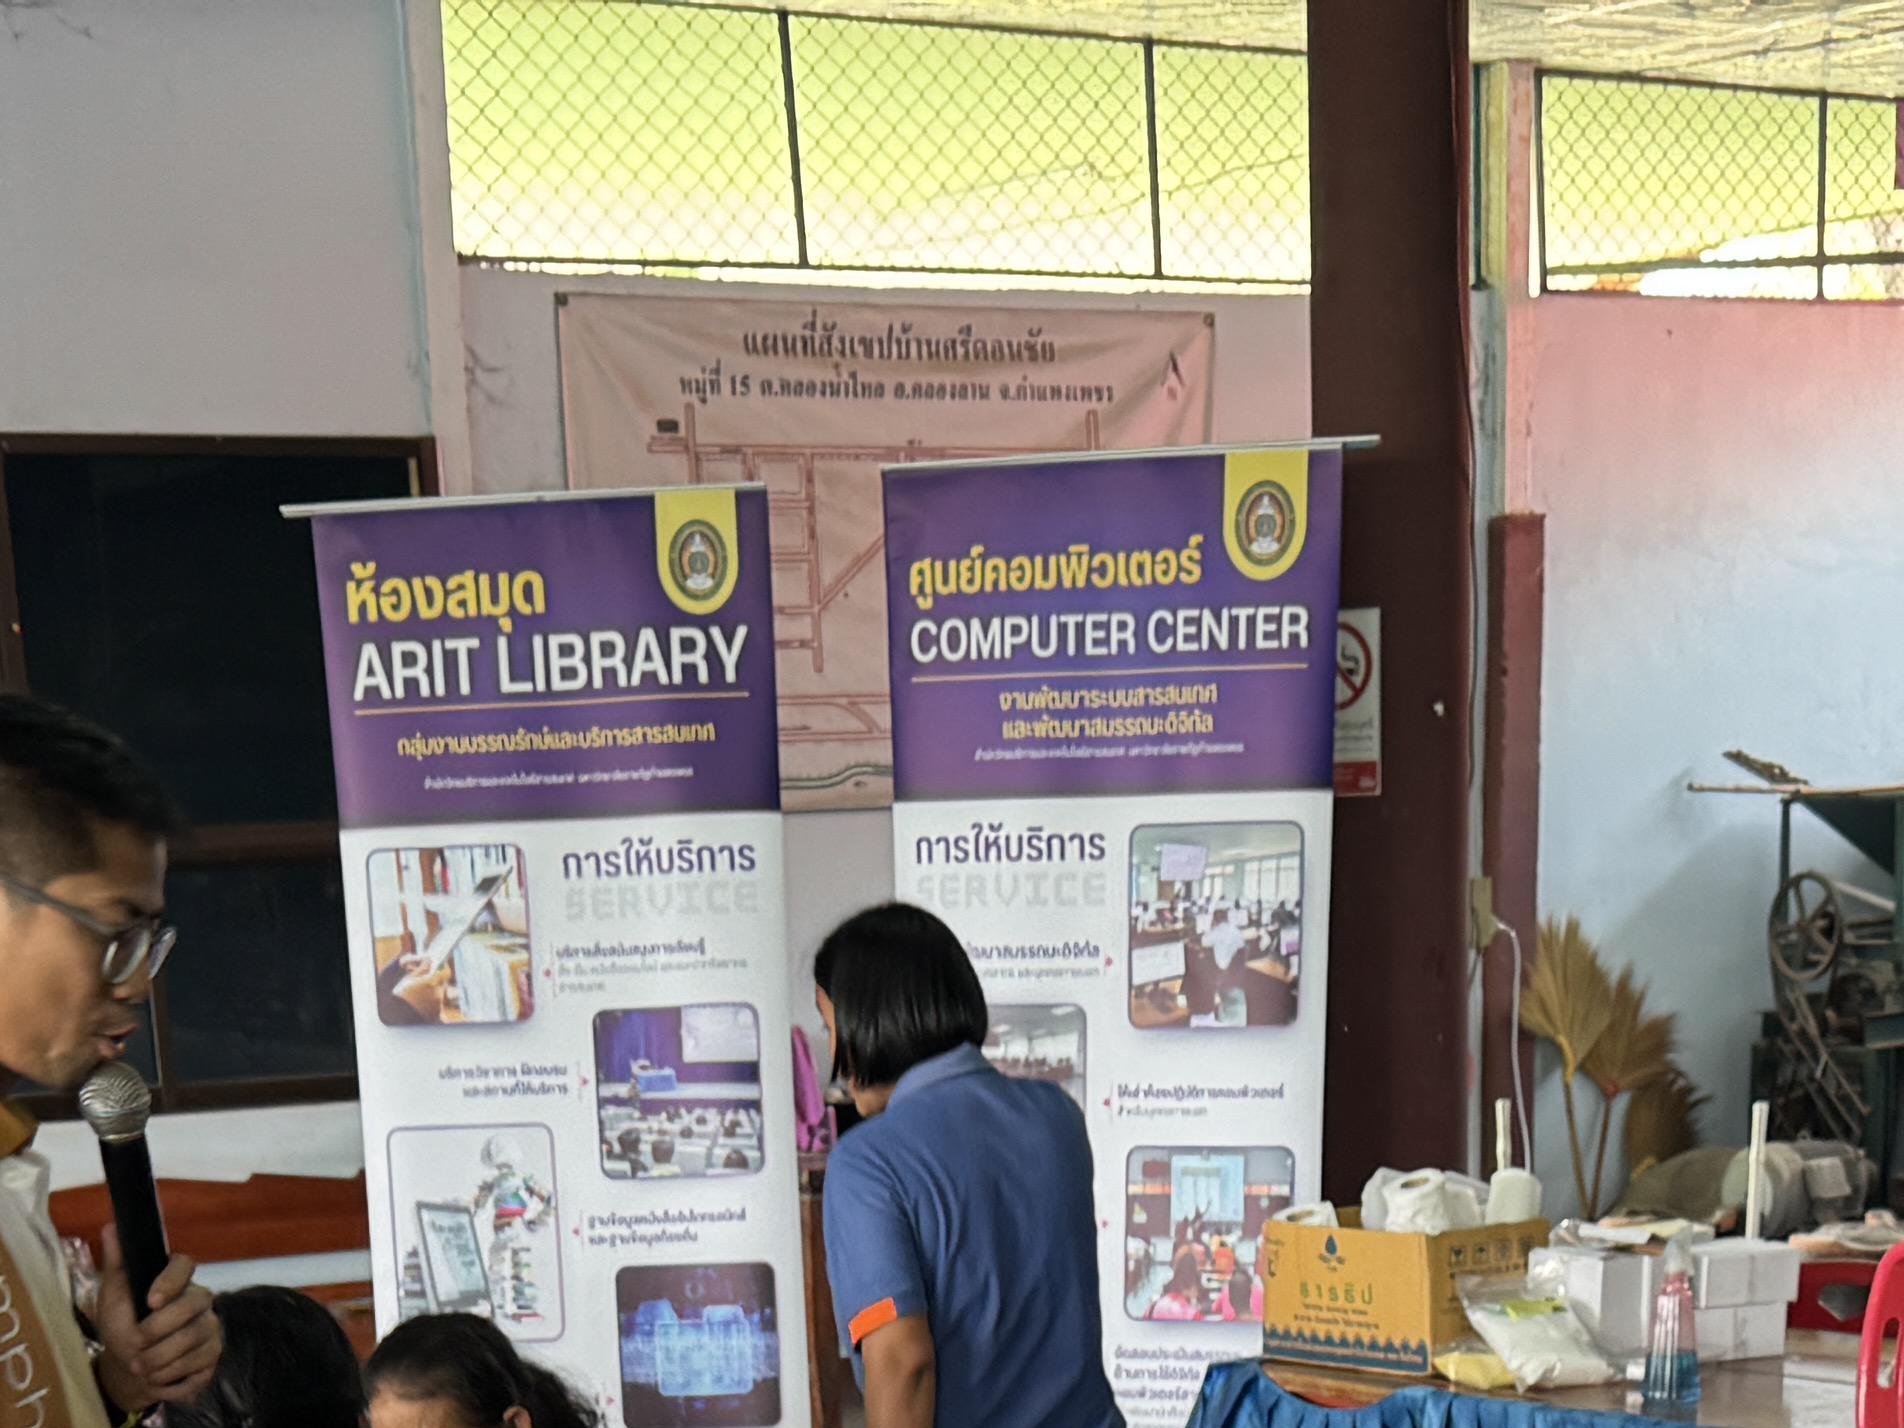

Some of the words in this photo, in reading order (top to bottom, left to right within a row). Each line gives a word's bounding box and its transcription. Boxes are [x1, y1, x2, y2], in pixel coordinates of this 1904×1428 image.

[730, 375, 750, 396] 15
[909, 535, 1204, 609] ศูนย์คอมพิวเตอร์
[345, 561, 546, 632] ห้องสมุด
[911, 613, 1135, 663] COMPUTER
[1147, 606, 1309, 653] CENTER
[353, 638, 479, 701] ARIT
[495, 625, 748, 693] LIBRARY
[562, 838, 756, 880] การให้บริการ
[916, 823, 1106, 864] การให้บริการ
[564, 879, 759, 921] SERVICE
[916, 871, 1107, 910] SERVICE
